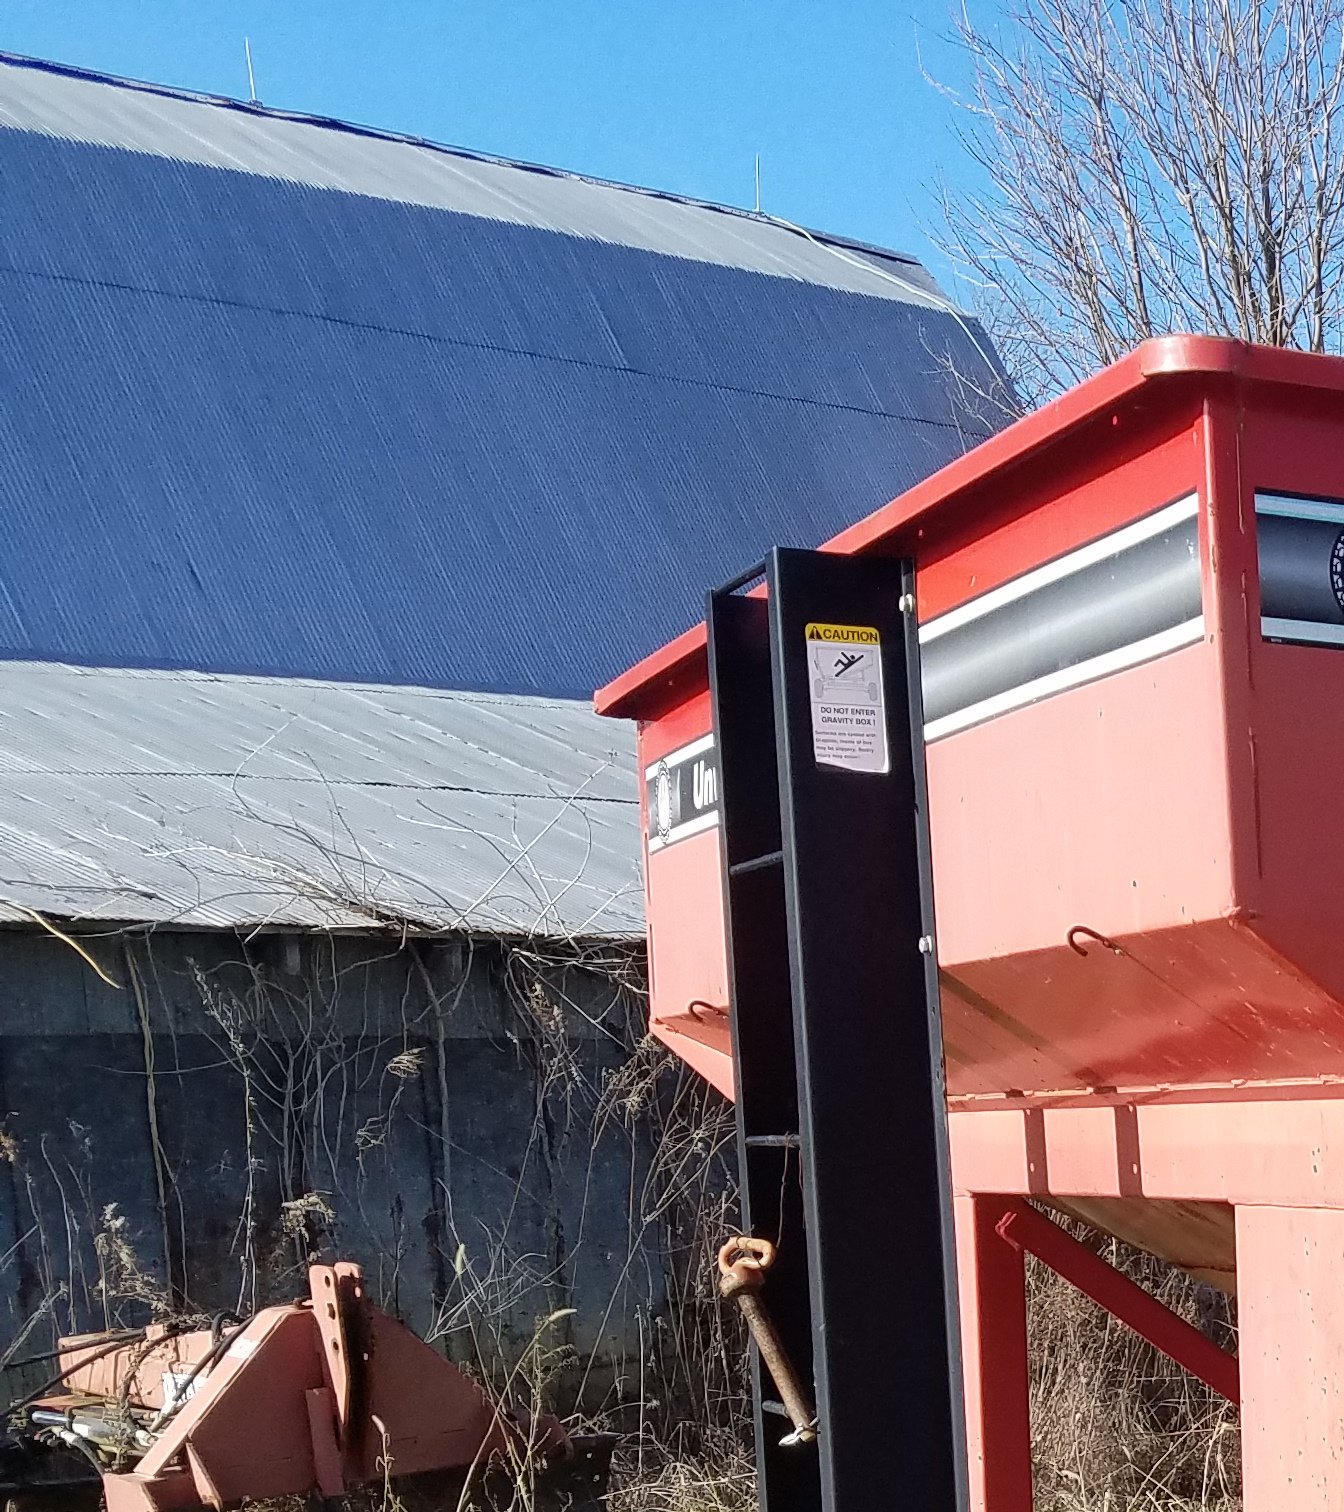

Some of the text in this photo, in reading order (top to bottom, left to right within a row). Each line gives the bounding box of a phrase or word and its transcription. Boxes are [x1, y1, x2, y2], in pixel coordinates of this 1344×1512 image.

[823, 629, 878, 642] CAUTION
[834, 707, 849, 715] NOT
[851, 708, 876, 716] ENTER
[821, 716, 854, 725] GRAVITY
